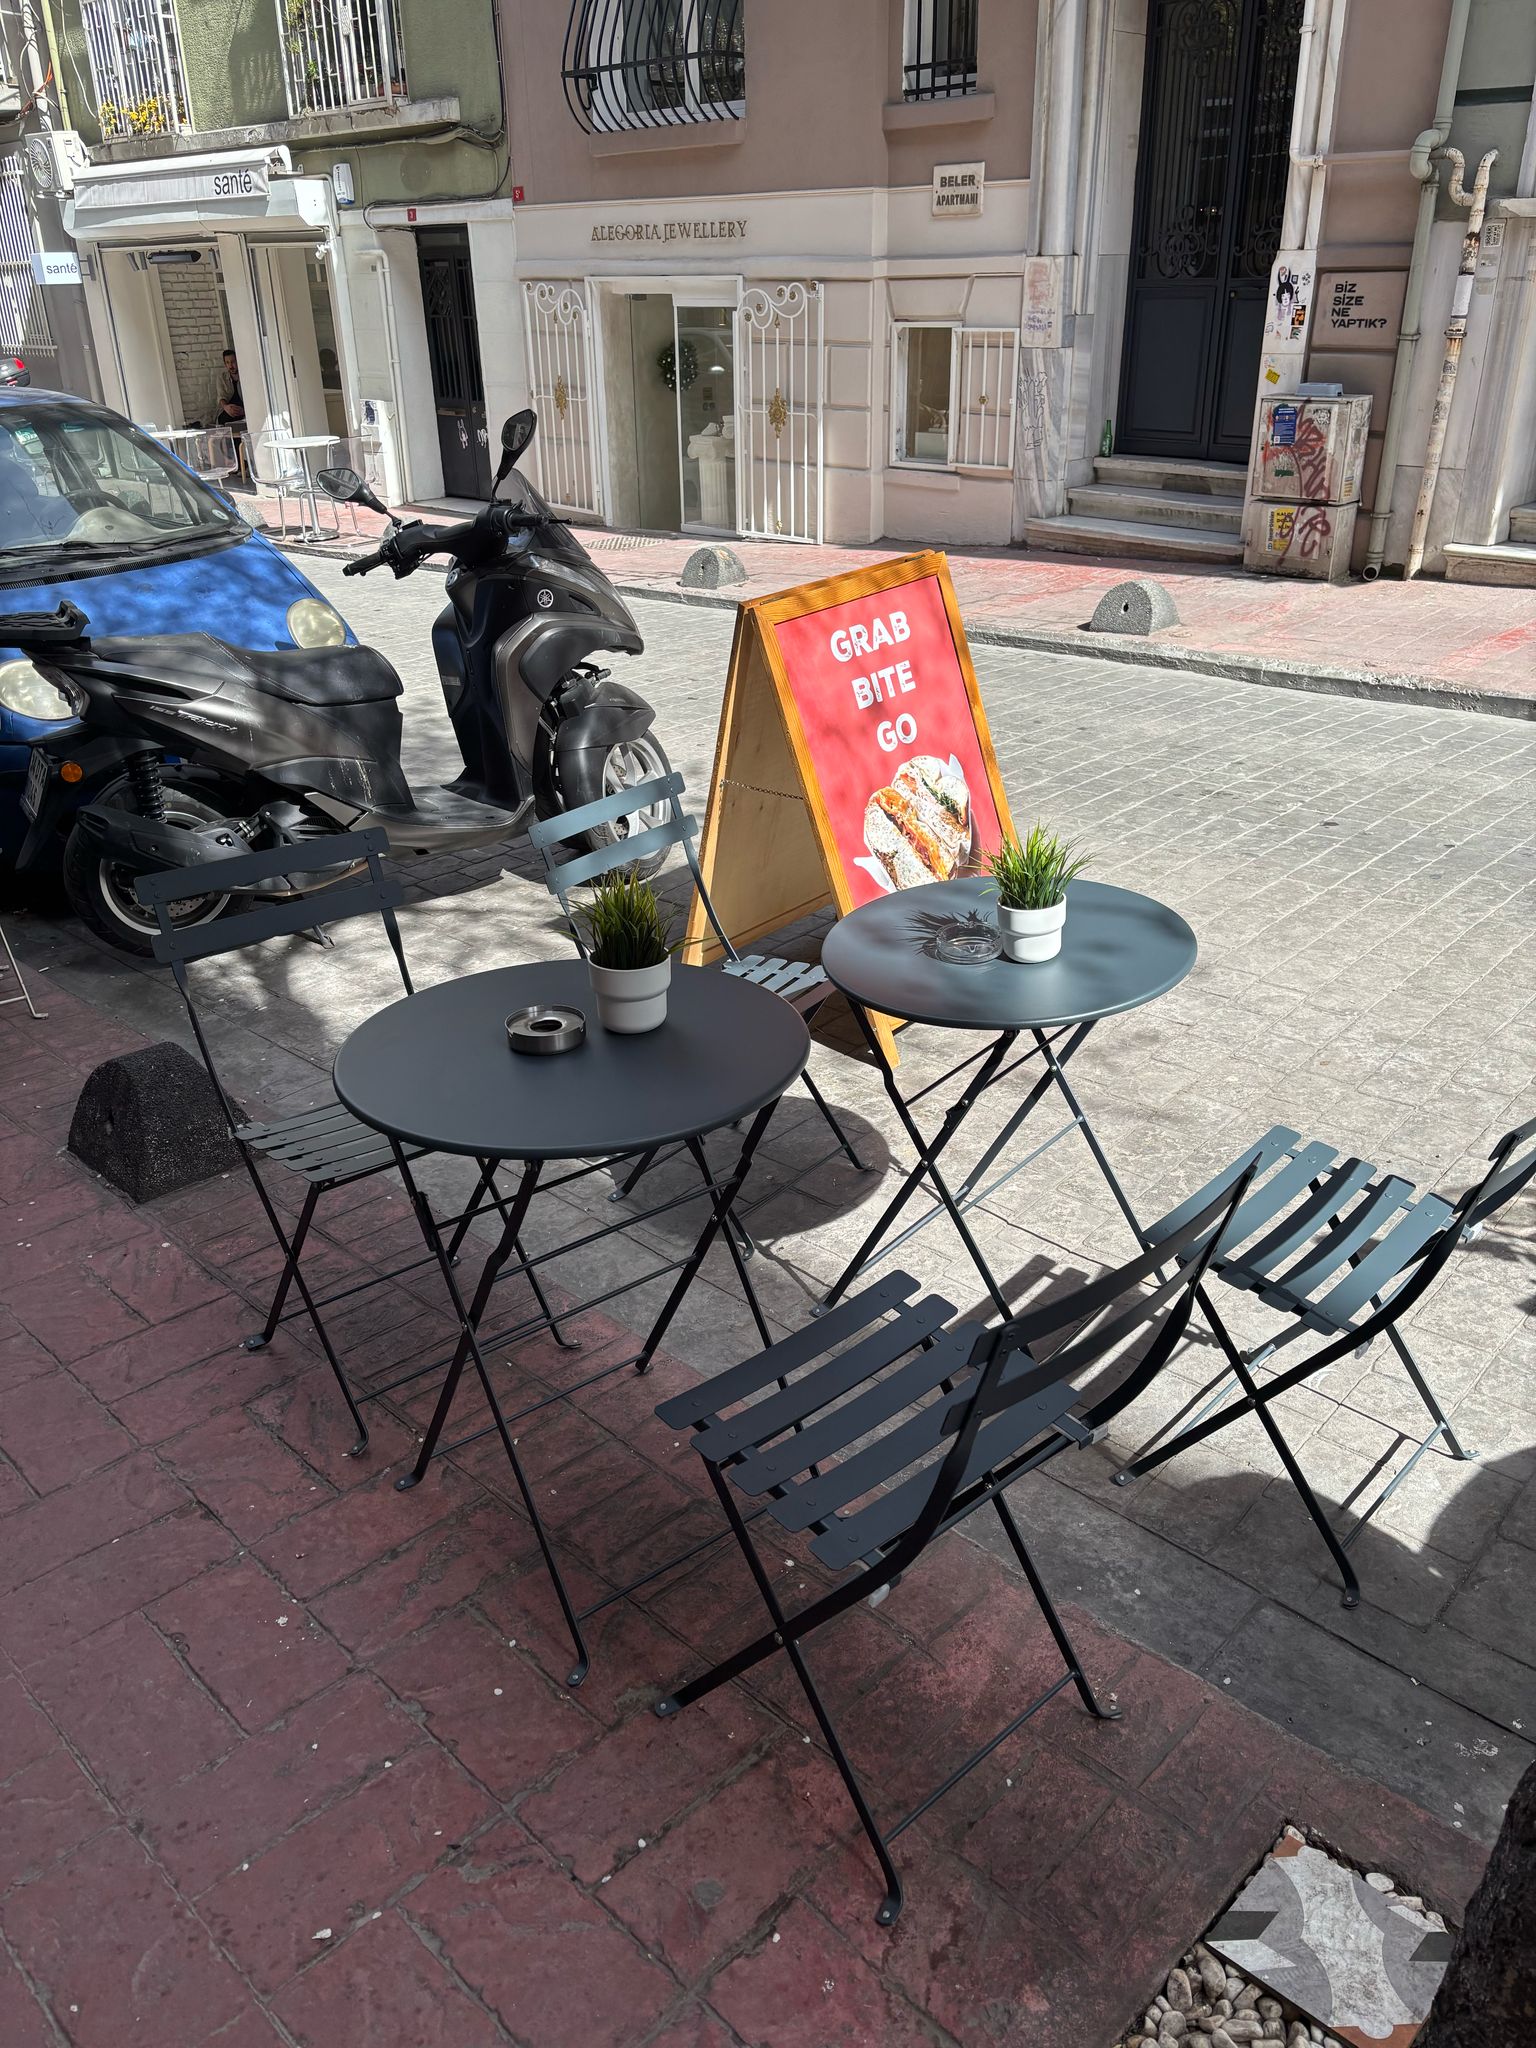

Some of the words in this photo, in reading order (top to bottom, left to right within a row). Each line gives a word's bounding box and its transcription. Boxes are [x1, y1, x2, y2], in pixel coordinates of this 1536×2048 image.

[214, 169, 252, 196] santé
[940, 174, 976, 188] BELER
[936, 193, 978, 206] APARTMANI
[591, 223, 661, 242] ALEGORIA
[662, 220, 747, 243] JEWELLERY
[46, 262, 78, 274] santé
[1334, 281, 1357, 293] BİZ
[1333, 294, 1364, 306] SİZE
[1331, 307, 1351, 317] NE
[1331, 318, 1388, 329] YAPTIK?
[830, 610, 911, 663] GRAB
[851, 660, 916, 710] BITE
[876, 712, 918, 753] GO
